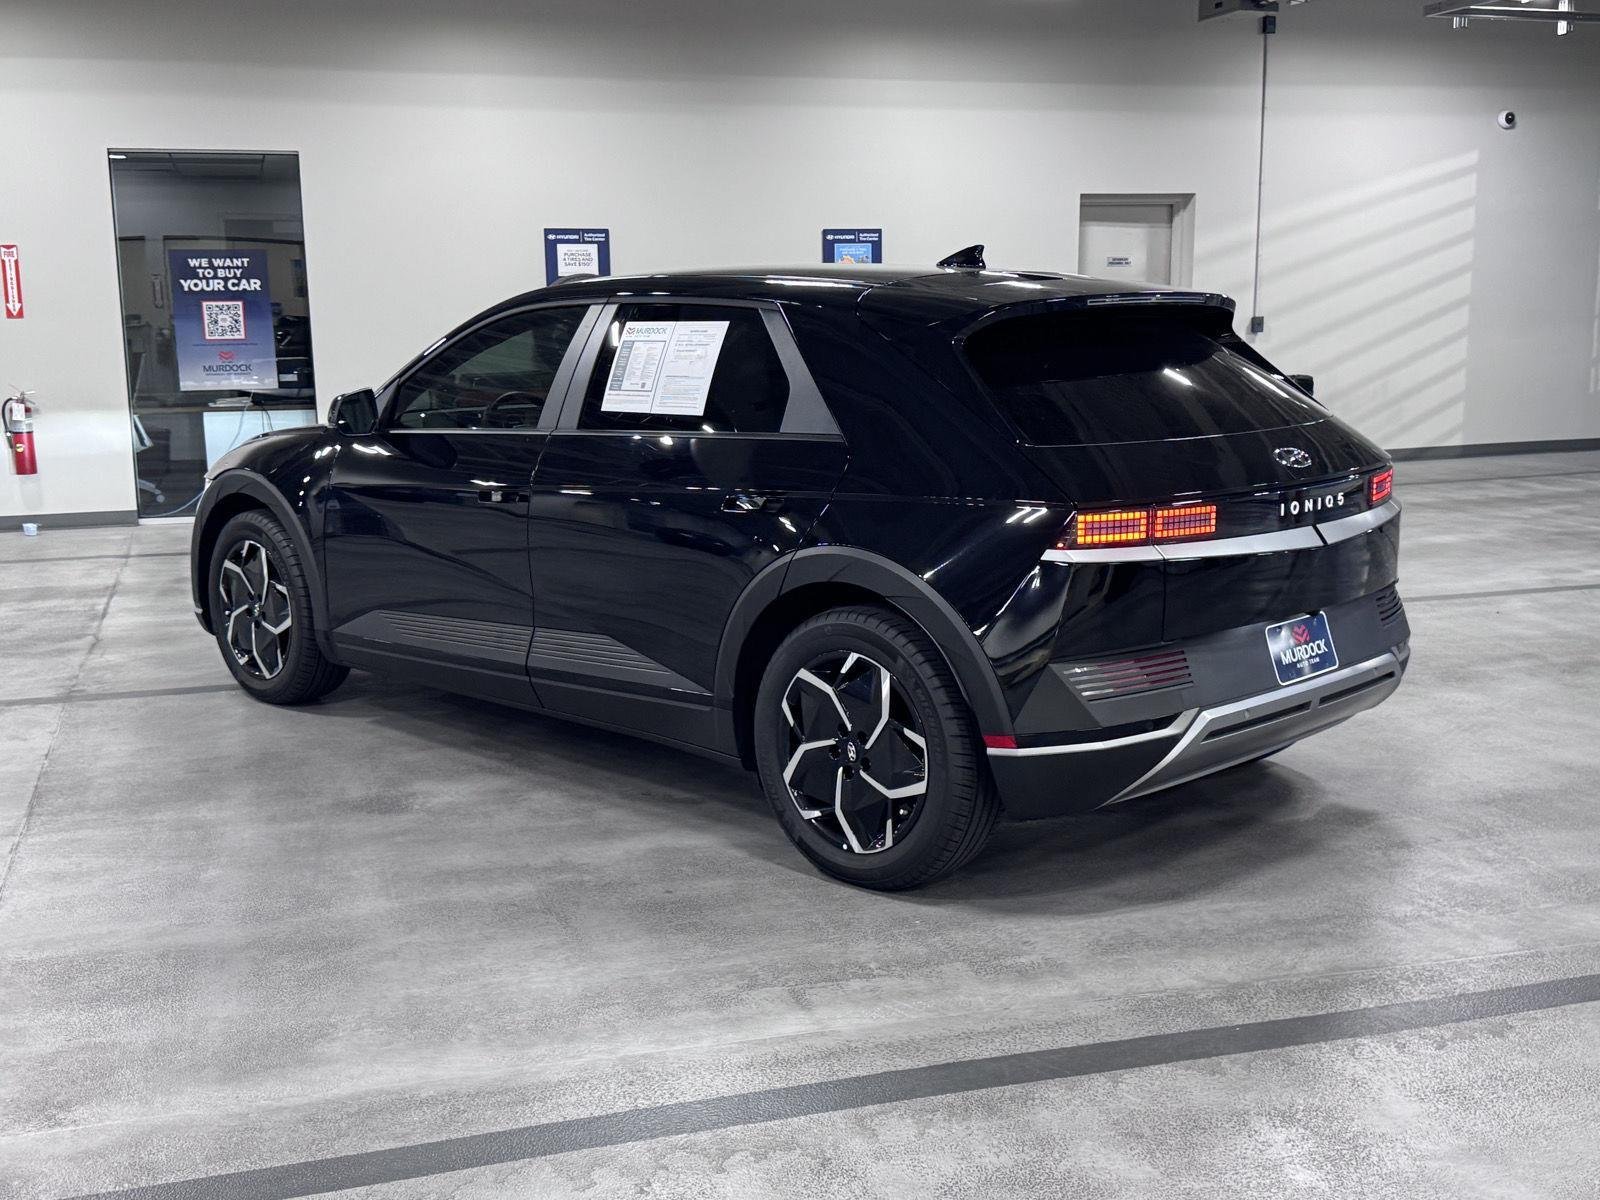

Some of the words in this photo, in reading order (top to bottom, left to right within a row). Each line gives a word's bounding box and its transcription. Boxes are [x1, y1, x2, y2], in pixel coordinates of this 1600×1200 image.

[3, 250, 15, 258] FIRE
[187, 258, 210, 267] WE
[211, 258, 250, 267] WANT
[196, 268, 214, 278] TO
[217, 268, 242, 278] BUY
[179, 279, 225, 291] YOUR
[227, 278, 262, 291] CAR
[635, 327, 668, 335] MURDOCK
[203, 364, 252, 372] MURDOCK
[1280, 638, 1328, 666] MURDOCK
[1296, 659, 1309, 669] AUTO
[1309, 656, 1320, 665] TEAM
